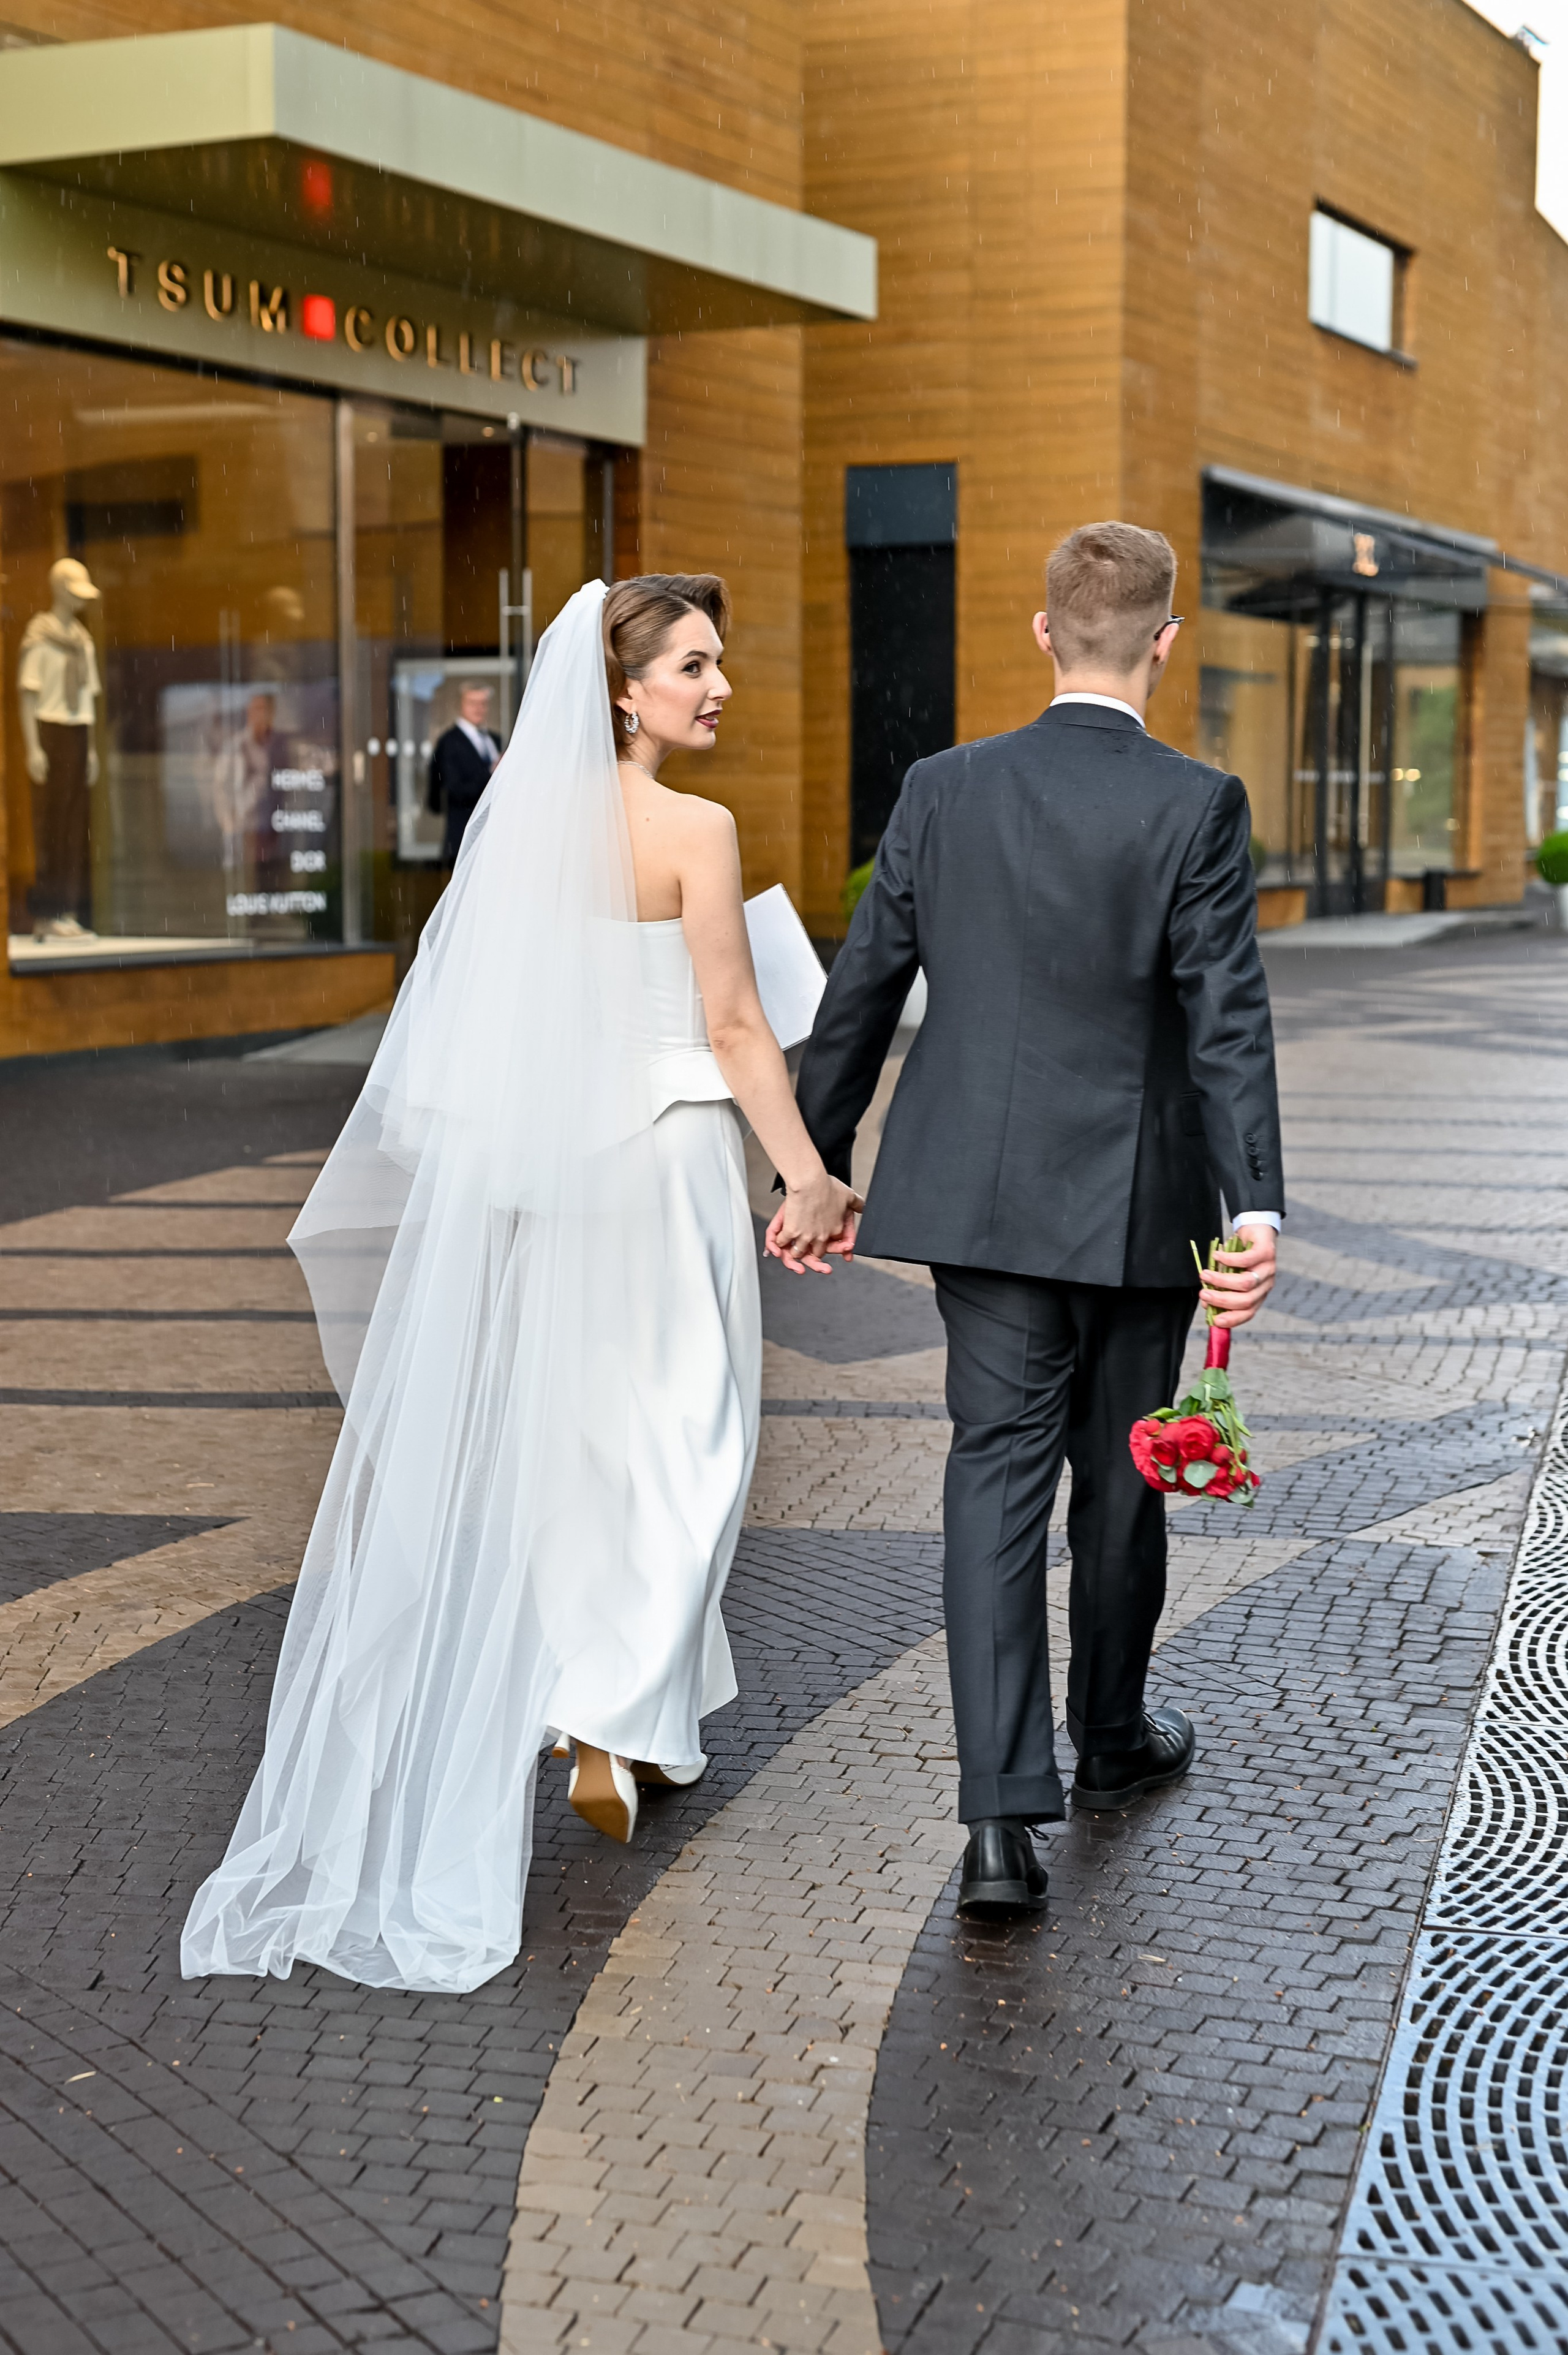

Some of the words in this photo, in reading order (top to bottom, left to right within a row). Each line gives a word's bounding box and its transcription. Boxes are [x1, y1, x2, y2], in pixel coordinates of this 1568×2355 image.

[107, 246, 287, 334] TSUM
[344, 304, 581, 395] COLLECT
[271, 809, 326, 833] CHANEL
